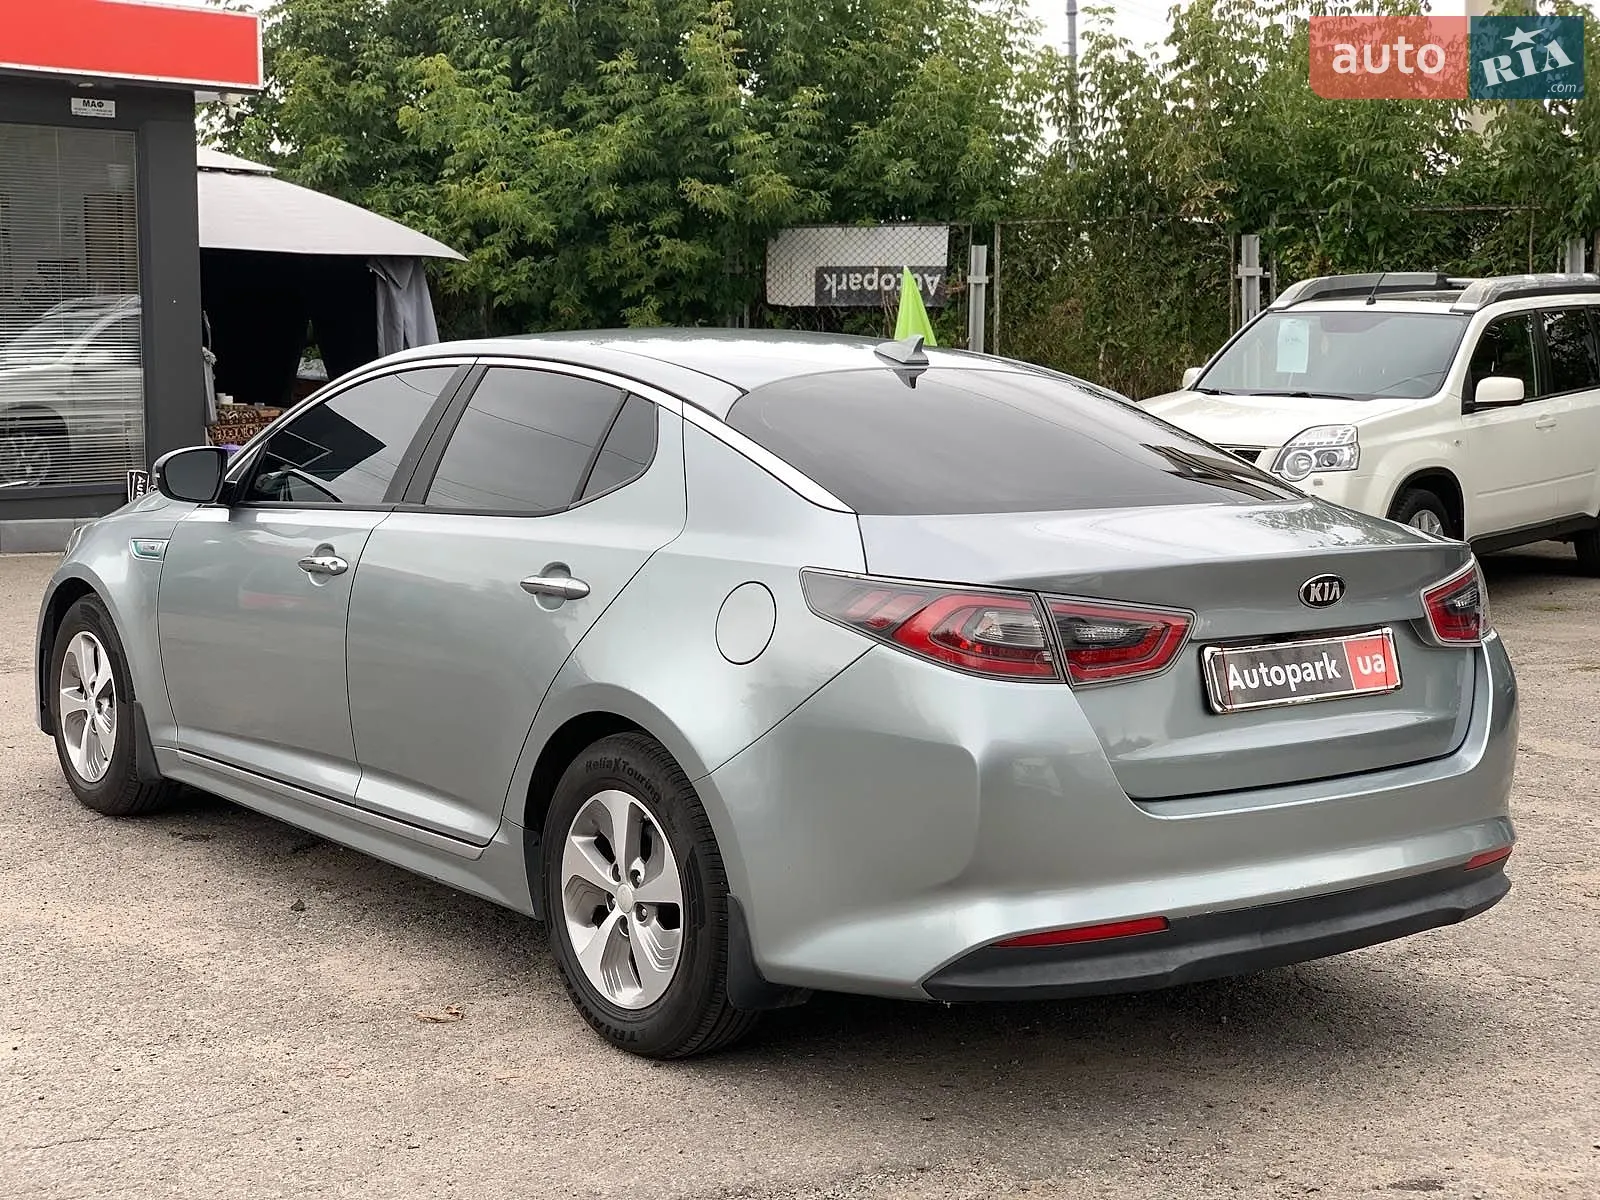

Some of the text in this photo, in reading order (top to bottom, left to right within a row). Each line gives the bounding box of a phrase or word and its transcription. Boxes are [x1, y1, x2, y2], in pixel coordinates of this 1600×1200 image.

[1309, 581, 1341, 602] KIA
[1228, 652, 1386, 692] Autopark ua
